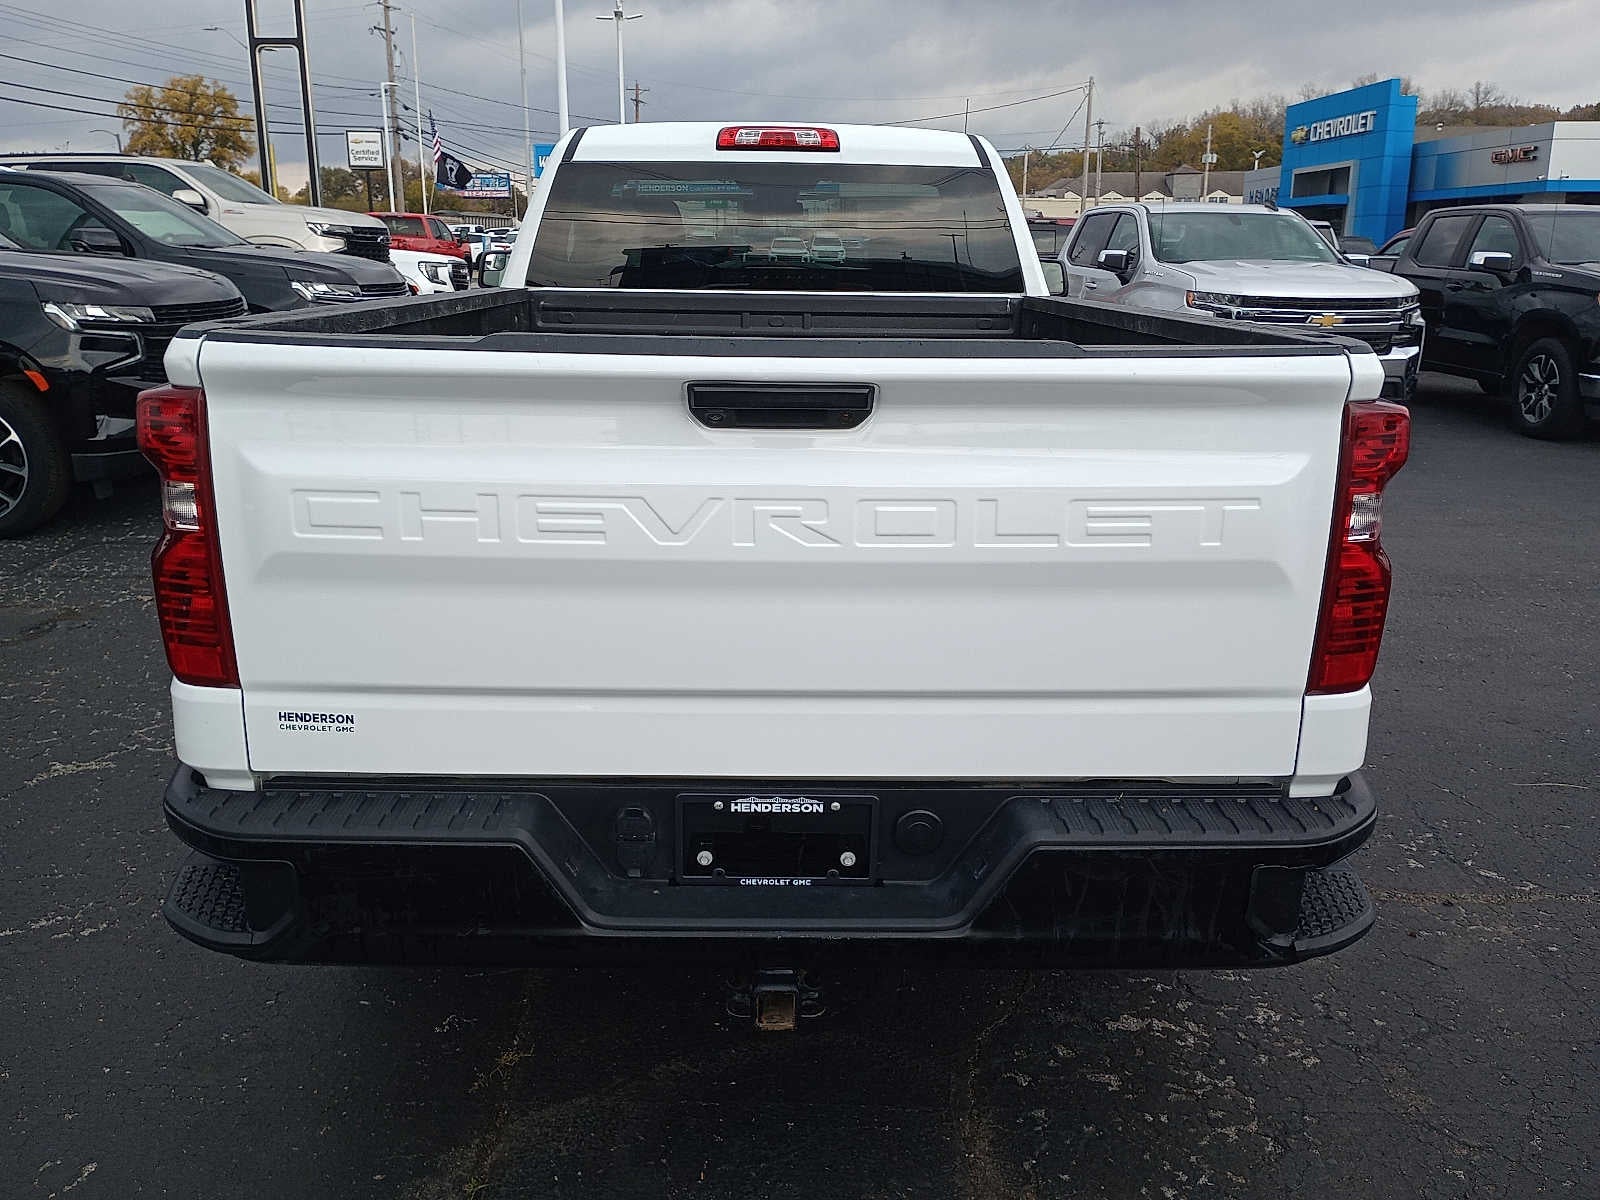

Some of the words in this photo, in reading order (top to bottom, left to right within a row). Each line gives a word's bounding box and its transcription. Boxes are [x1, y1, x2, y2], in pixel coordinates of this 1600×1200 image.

[1310, 110, 1377, 142] CHEVROLET
[1491, 146, 1537, 164] GMC
[292, 489, 1262, 549] CHEVROLET
[278, 711, 355, 725] HENDERSON
[279, 723, 333, 732] CHEVROLET
[730, 802, 824, 814] HENDERSON
[740, 878, 790, 886] CHEVROLET
[792, 878, 812, 886] GMC
